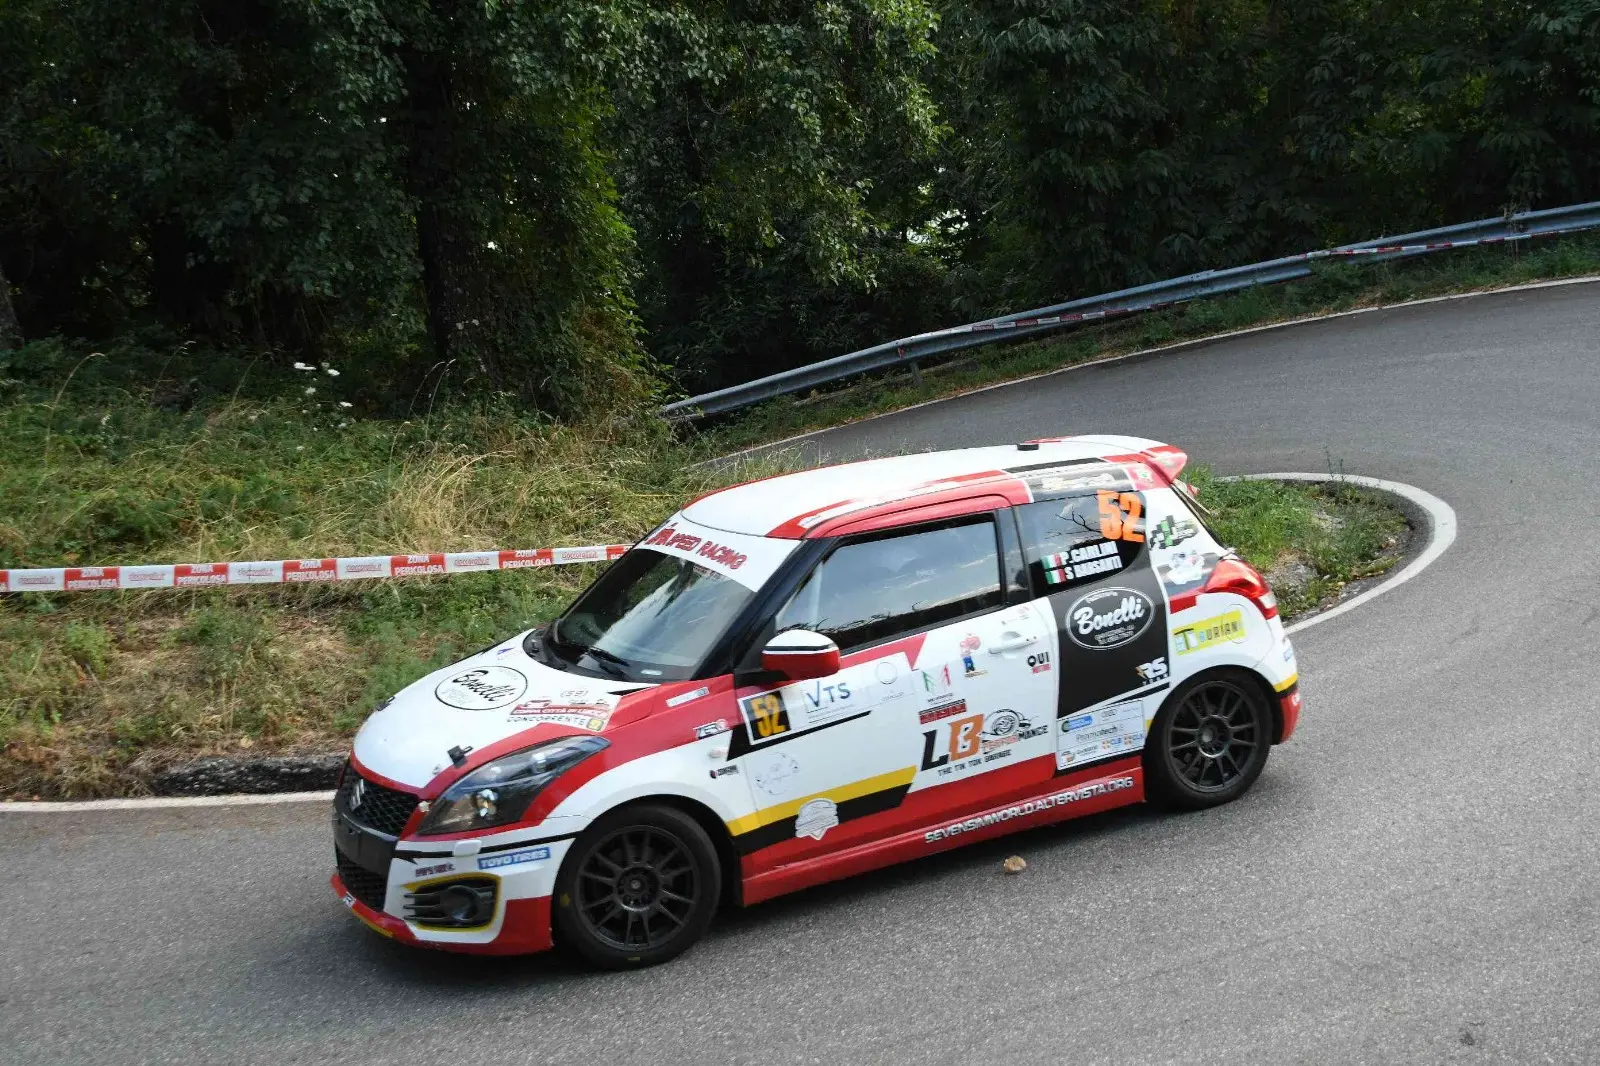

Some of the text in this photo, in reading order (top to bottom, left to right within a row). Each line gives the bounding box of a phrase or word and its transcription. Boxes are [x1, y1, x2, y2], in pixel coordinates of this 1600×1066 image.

[1097, 489, 1146, 543] 52
[515, 550, 538, 558] ZONA
[394, 564, 444, 576] PERICOLOSA
[502, 558, 552, 569] PERICOLOSA
[285, 570, 337, 581] PERICOLOSA
[1073, 596, 1145, 635] Bonelli
[1027, 651, 1050, 668] QUI
[452, 670, 517, 702] Bonelli
[806, 680, 851, 708] VTS
[750, 693, 788, 738] 52
[937, 766, 953, 776] THE
[480, 850, 547, 868] TOYO TIRES
